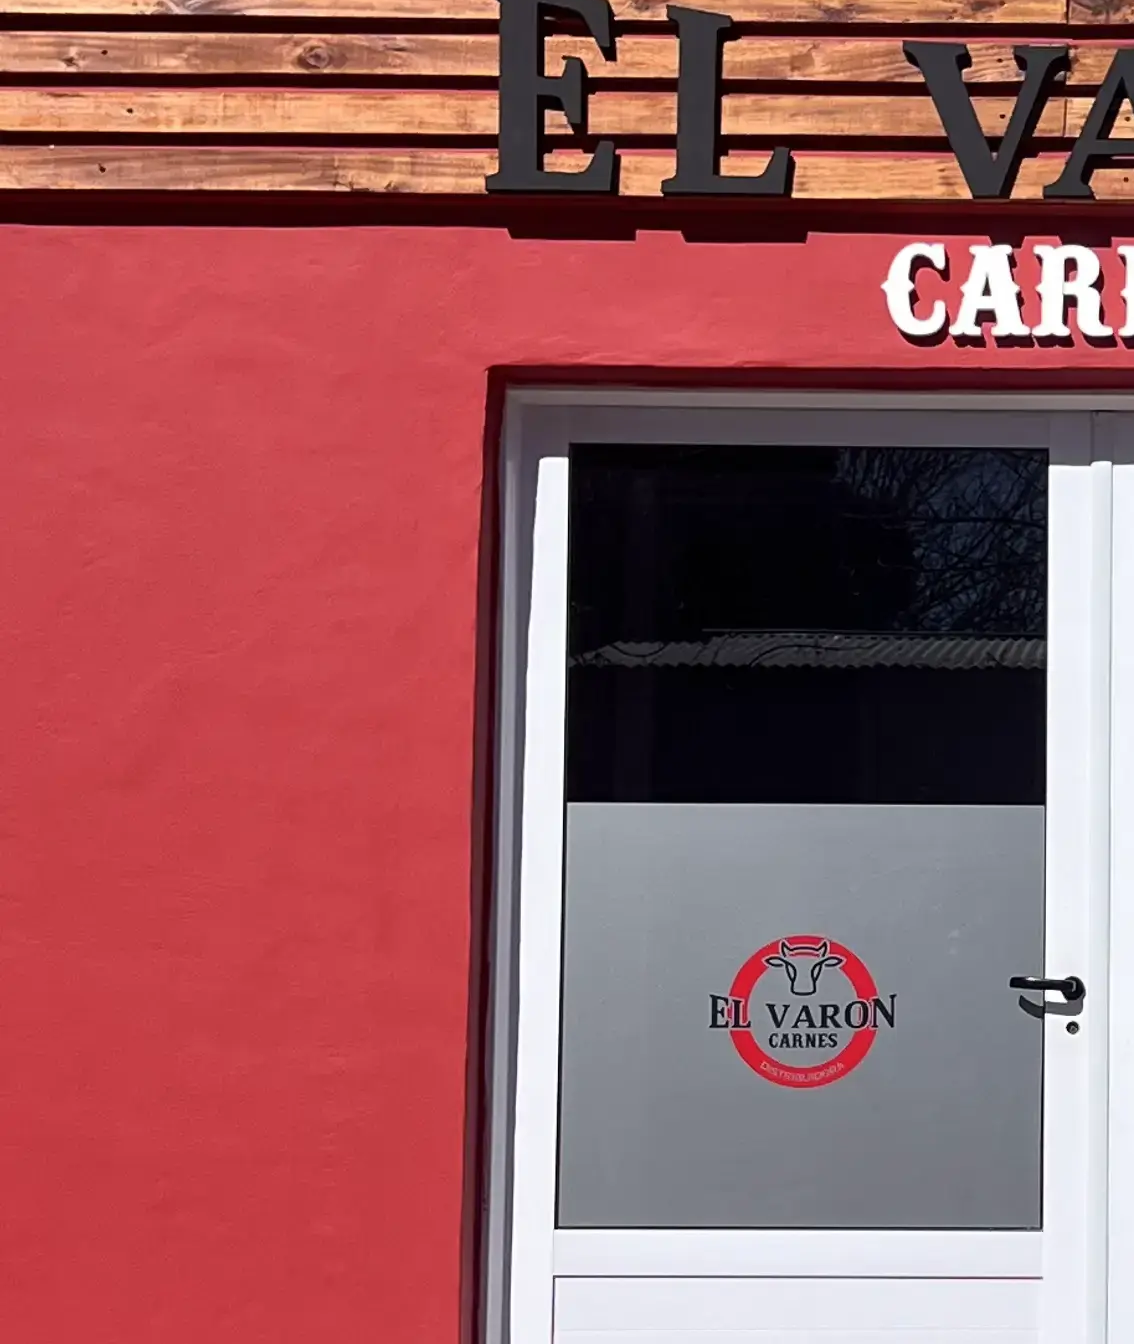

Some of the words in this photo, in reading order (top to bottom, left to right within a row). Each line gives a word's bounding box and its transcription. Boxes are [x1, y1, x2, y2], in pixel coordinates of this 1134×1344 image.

[709, 994, 752, 1029] EL
[765, 994, 898, 1029] VARON
[769, 1033, 838, 1049] CARNES
